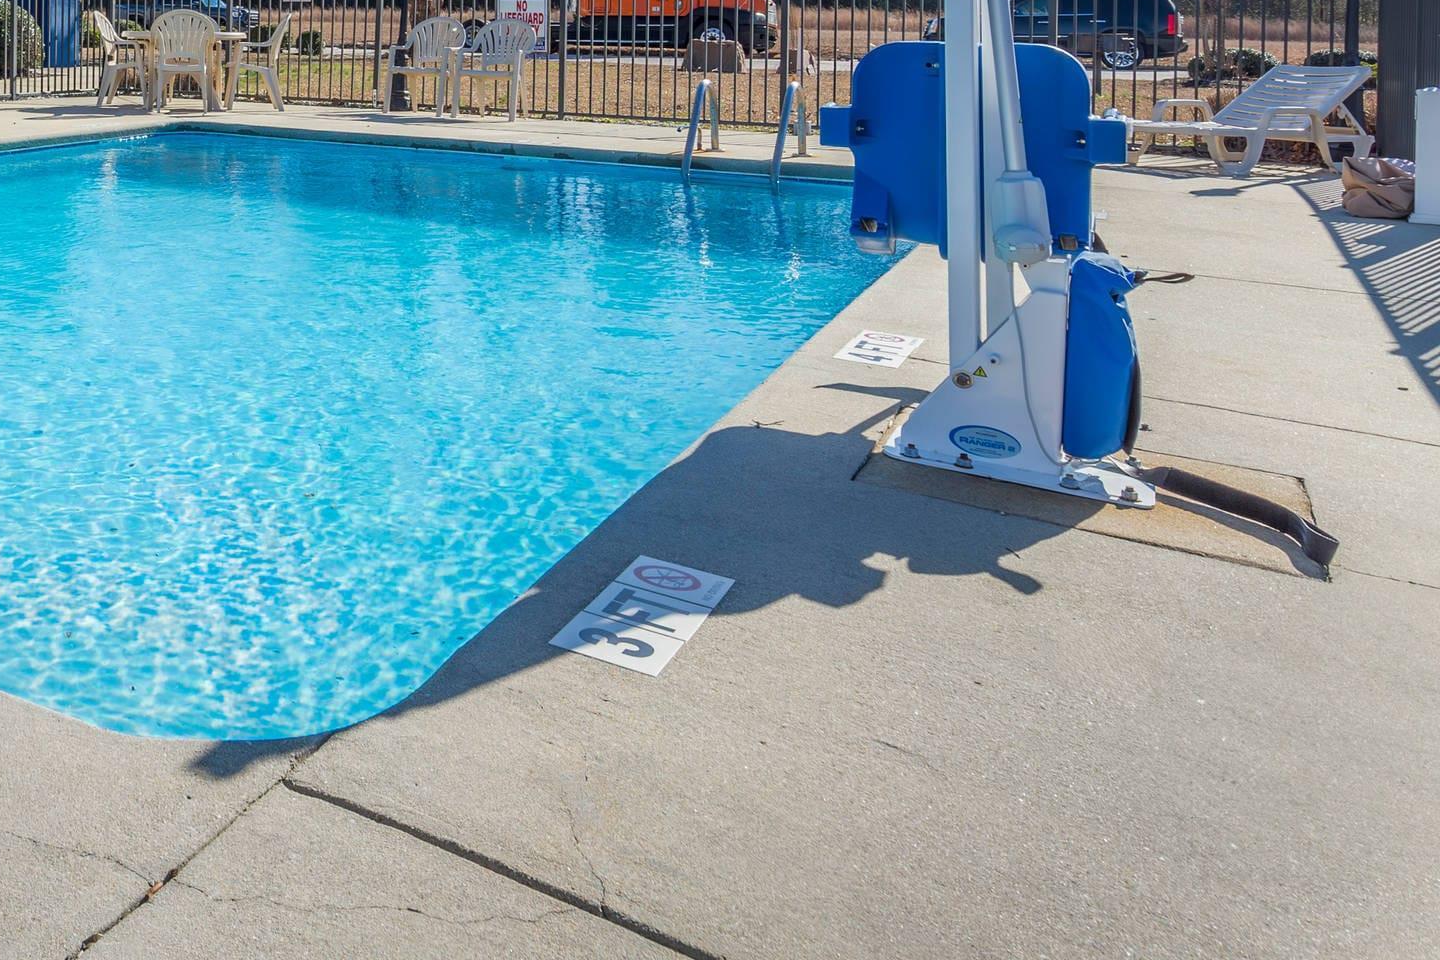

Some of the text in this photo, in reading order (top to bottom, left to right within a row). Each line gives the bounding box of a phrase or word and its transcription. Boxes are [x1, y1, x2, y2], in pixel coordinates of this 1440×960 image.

[516, 0, 528, 12] NO
[959, 436, 1006, 450] RANGER
[579, 588, 690, 658] 3 FT
